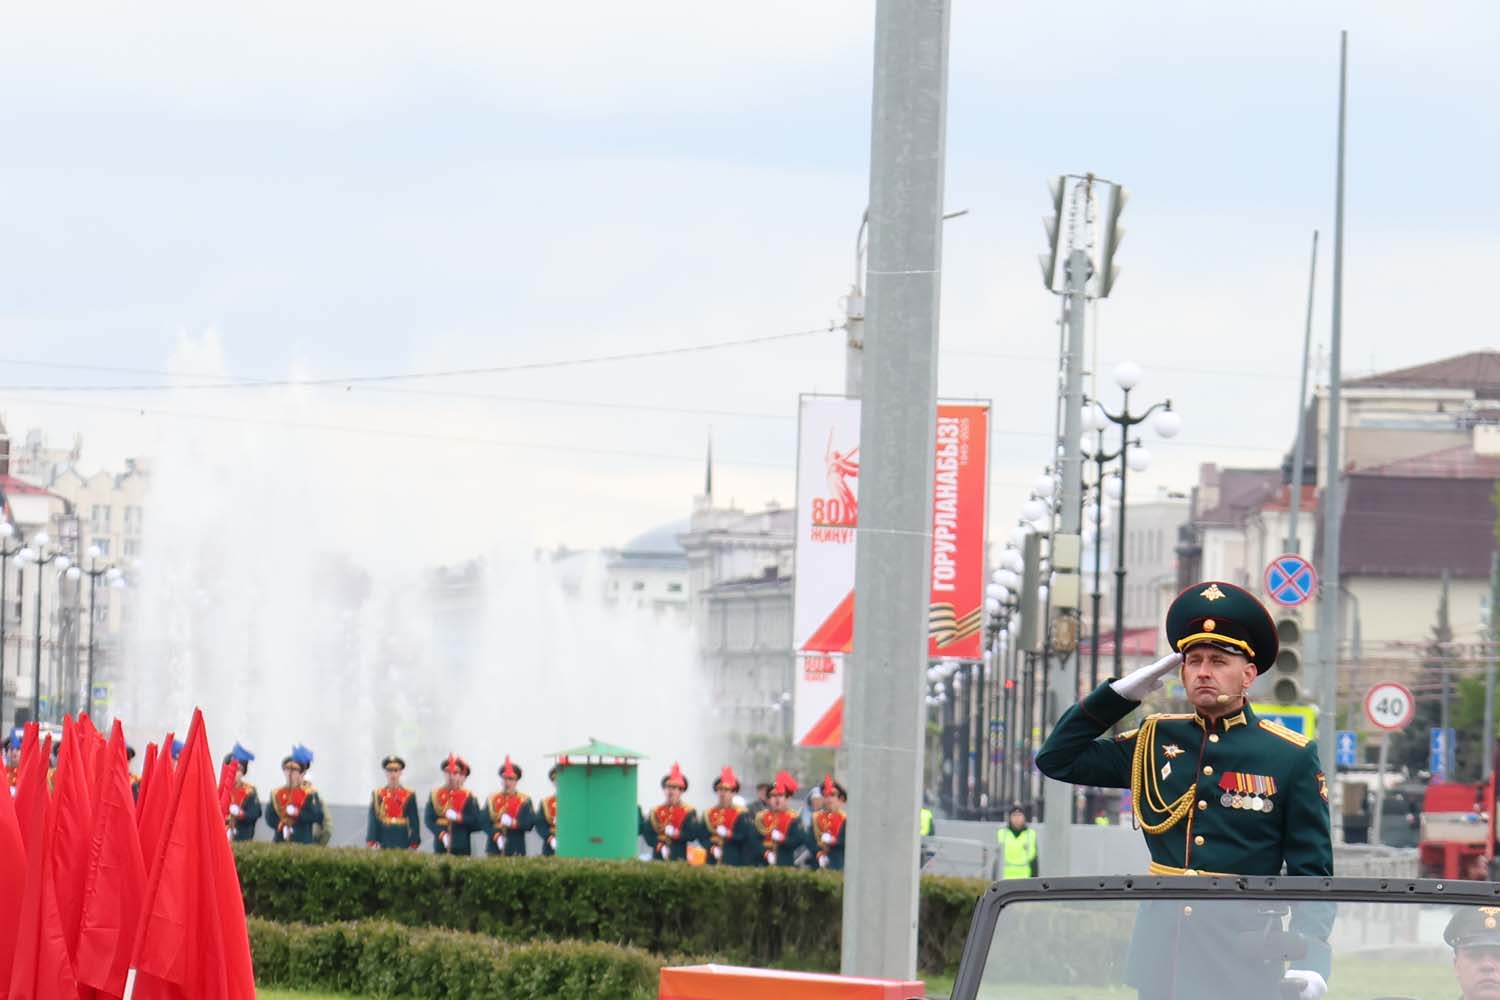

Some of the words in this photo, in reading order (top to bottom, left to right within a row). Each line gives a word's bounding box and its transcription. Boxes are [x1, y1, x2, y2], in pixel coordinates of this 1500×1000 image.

[811, 498, 840, 524] 80
[933, 416, 960, 592] ГОРУРЛАНАБЫЗ!
[1375, 697, 1403, 717] 40
